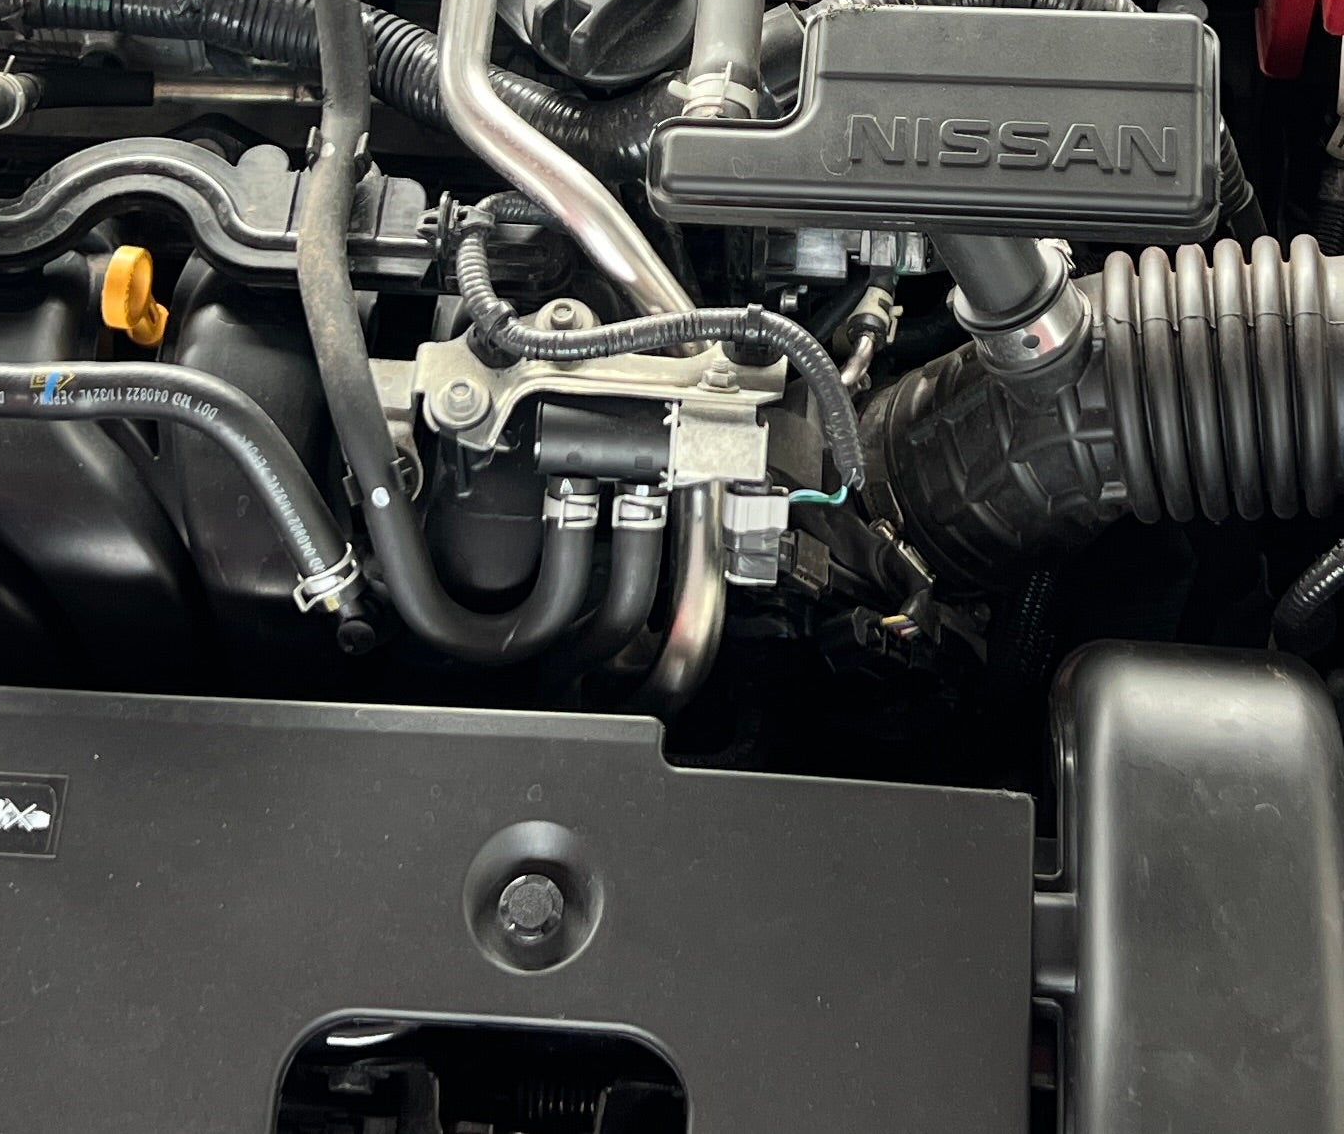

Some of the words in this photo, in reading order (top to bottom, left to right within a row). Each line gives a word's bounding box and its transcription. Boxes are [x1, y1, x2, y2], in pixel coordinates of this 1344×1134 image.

[846, 114, 1179, 176] NISSAN
[125, 386, 169, 404] 040822
[193, 399, 221, 420] DOT
